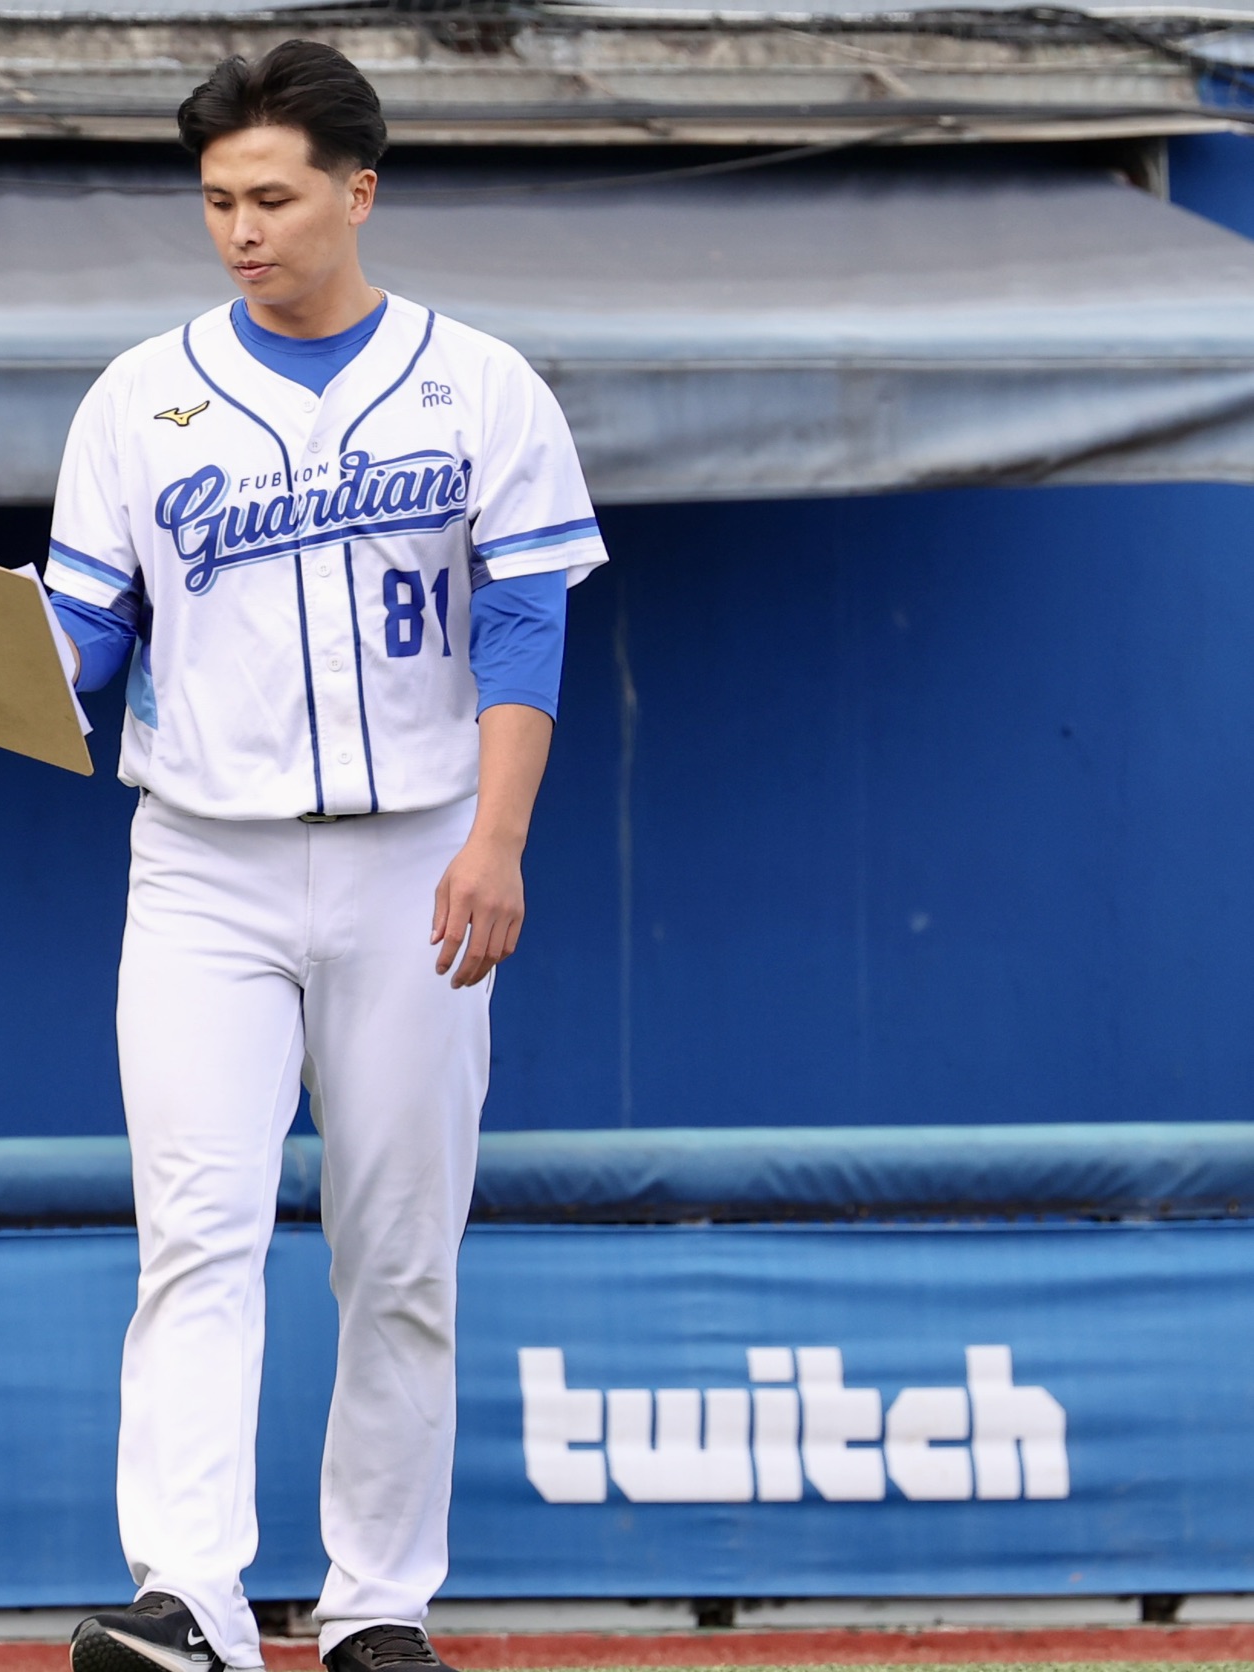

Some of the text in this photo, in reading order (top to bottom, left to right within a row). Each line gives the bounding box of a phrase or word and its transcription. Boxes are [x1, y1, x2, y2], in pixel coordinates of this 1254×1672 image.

[154, 449, 473, 596] Guardians
[382, 567, 452, 658] 81
[518, 1344, 1071, 1504] twitch
